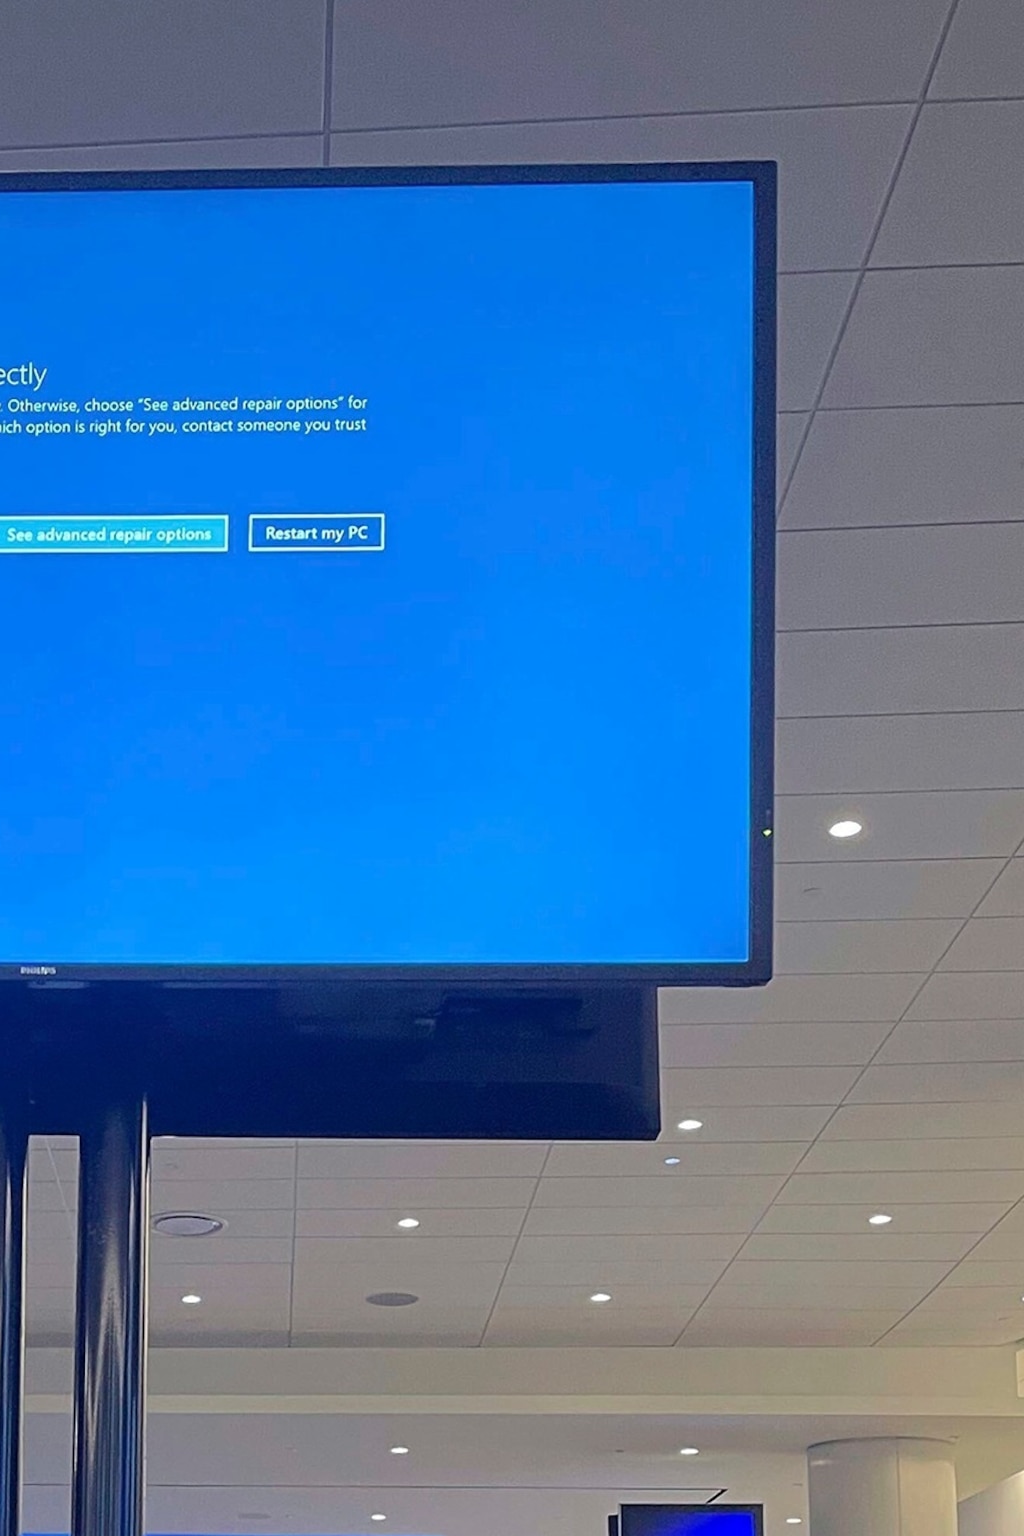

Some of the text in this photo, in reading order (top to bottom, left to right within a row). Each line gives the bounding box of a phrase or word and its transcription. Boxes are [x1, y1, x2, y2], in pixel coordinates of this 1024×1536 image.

[7, 398, 80, 414] Otherwise,
[84, 397, 134, 413] choose
[172, 396, 239, 412] advanced
[242, 399, 283, 414] repair
[347, 394, 368, 410] for
[25, 420, 71, 437] option
[74, 420, 86, 434] is
[89, 418, 122, 437] right
[125, 418, 146, 433] for
[148, 422, 178, 436] you,
[181, 420, 234, 433] contact
[236, 420, 301, 432] someone
[304, 420, 331, 435] you
[334, 418, 367, 431] trust
[7, 526, 212, 545] See advanced repair options
[265, 525, 369, 544] Restart my PC
